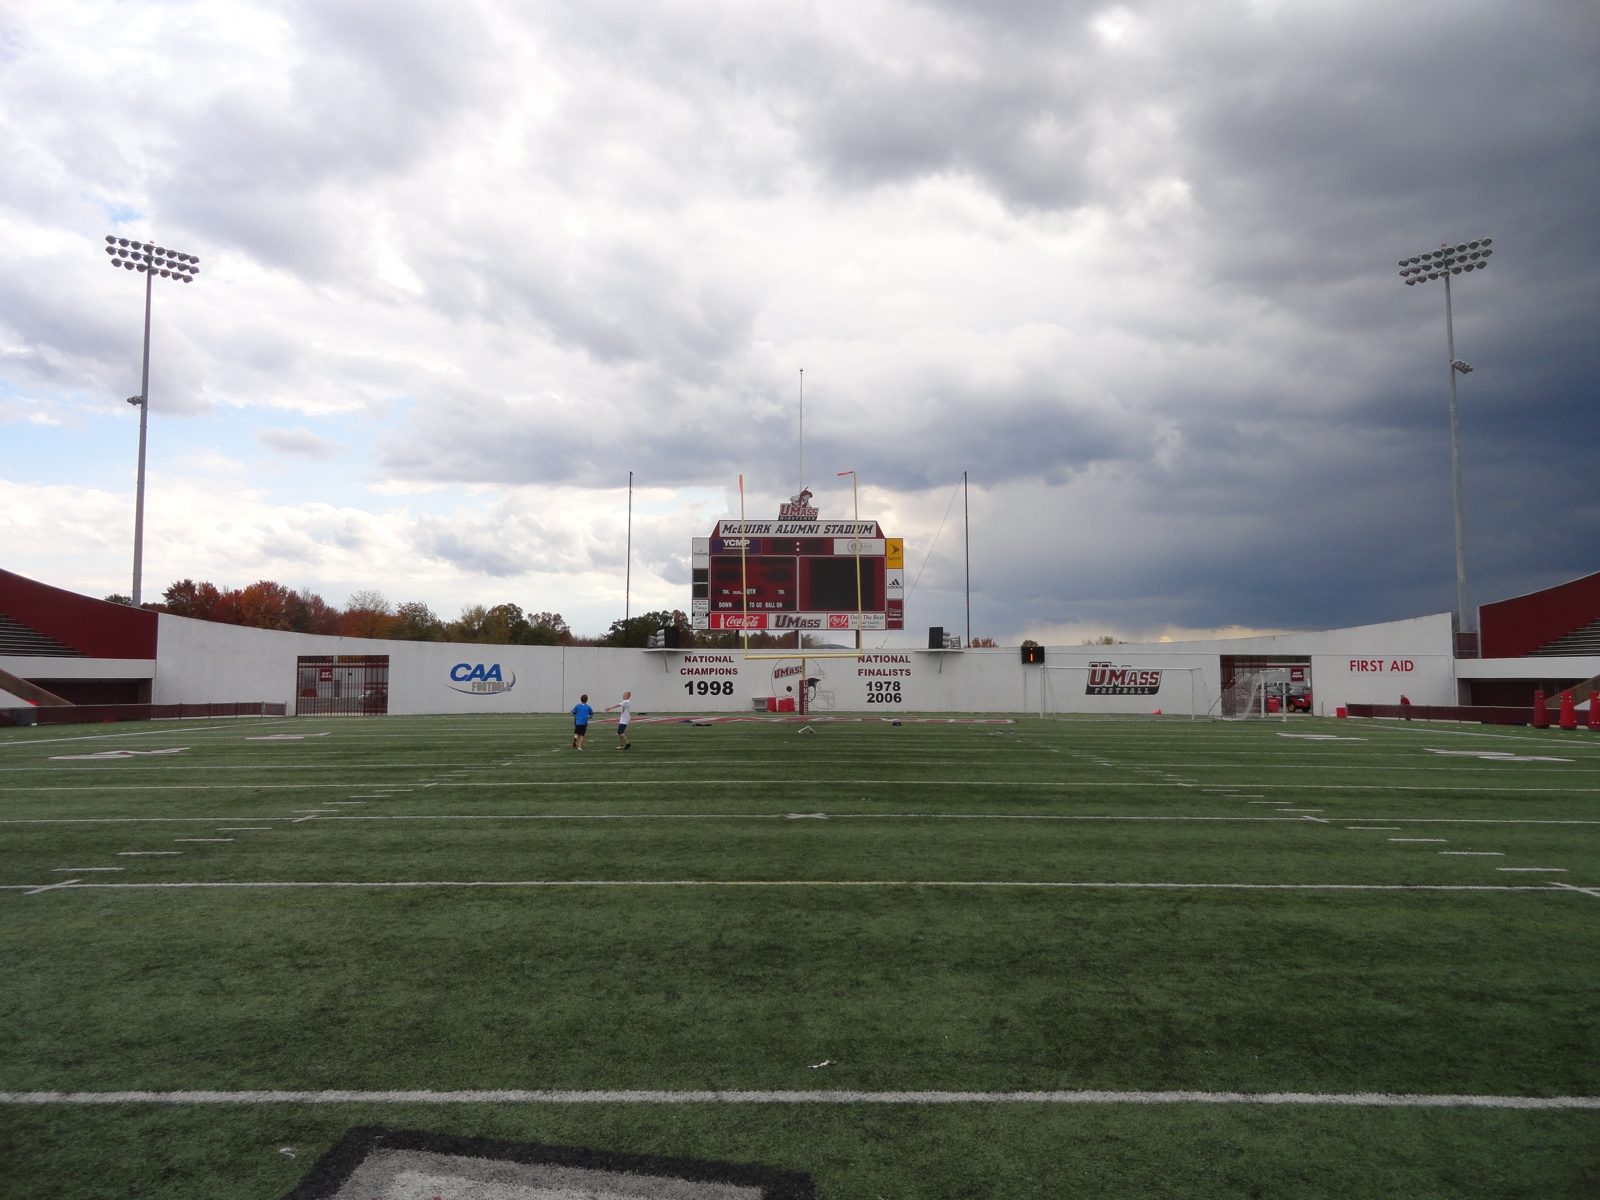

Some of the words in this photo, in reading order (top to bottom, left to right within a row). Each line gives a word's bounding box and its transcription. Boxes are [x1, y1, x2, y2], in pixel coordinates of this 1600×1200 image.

[775, 524, 820, 534] ALUMNI
[723, 539, 750, 547] YCMP
[726, 616, 759, 627] CocaCola
[684, 655, 734, 663] NATIONAL
[857, 655, 911, 663] NATIONAL
[680, 667, 738, 675] CHAMPIONS
[1350, 660, 1384, 672] FIRST
[1390, 660, 1414, 672] AID
[450, 663, 503, 682] CAA
[858, 668, 911, 677] FINALISTS
[472, 682, 511, 692] FOOTBALL
[684, 680, 734, 696] 1998
[866, 681, 901, 692] 1978
[867, 692, 902, 703] 2006
